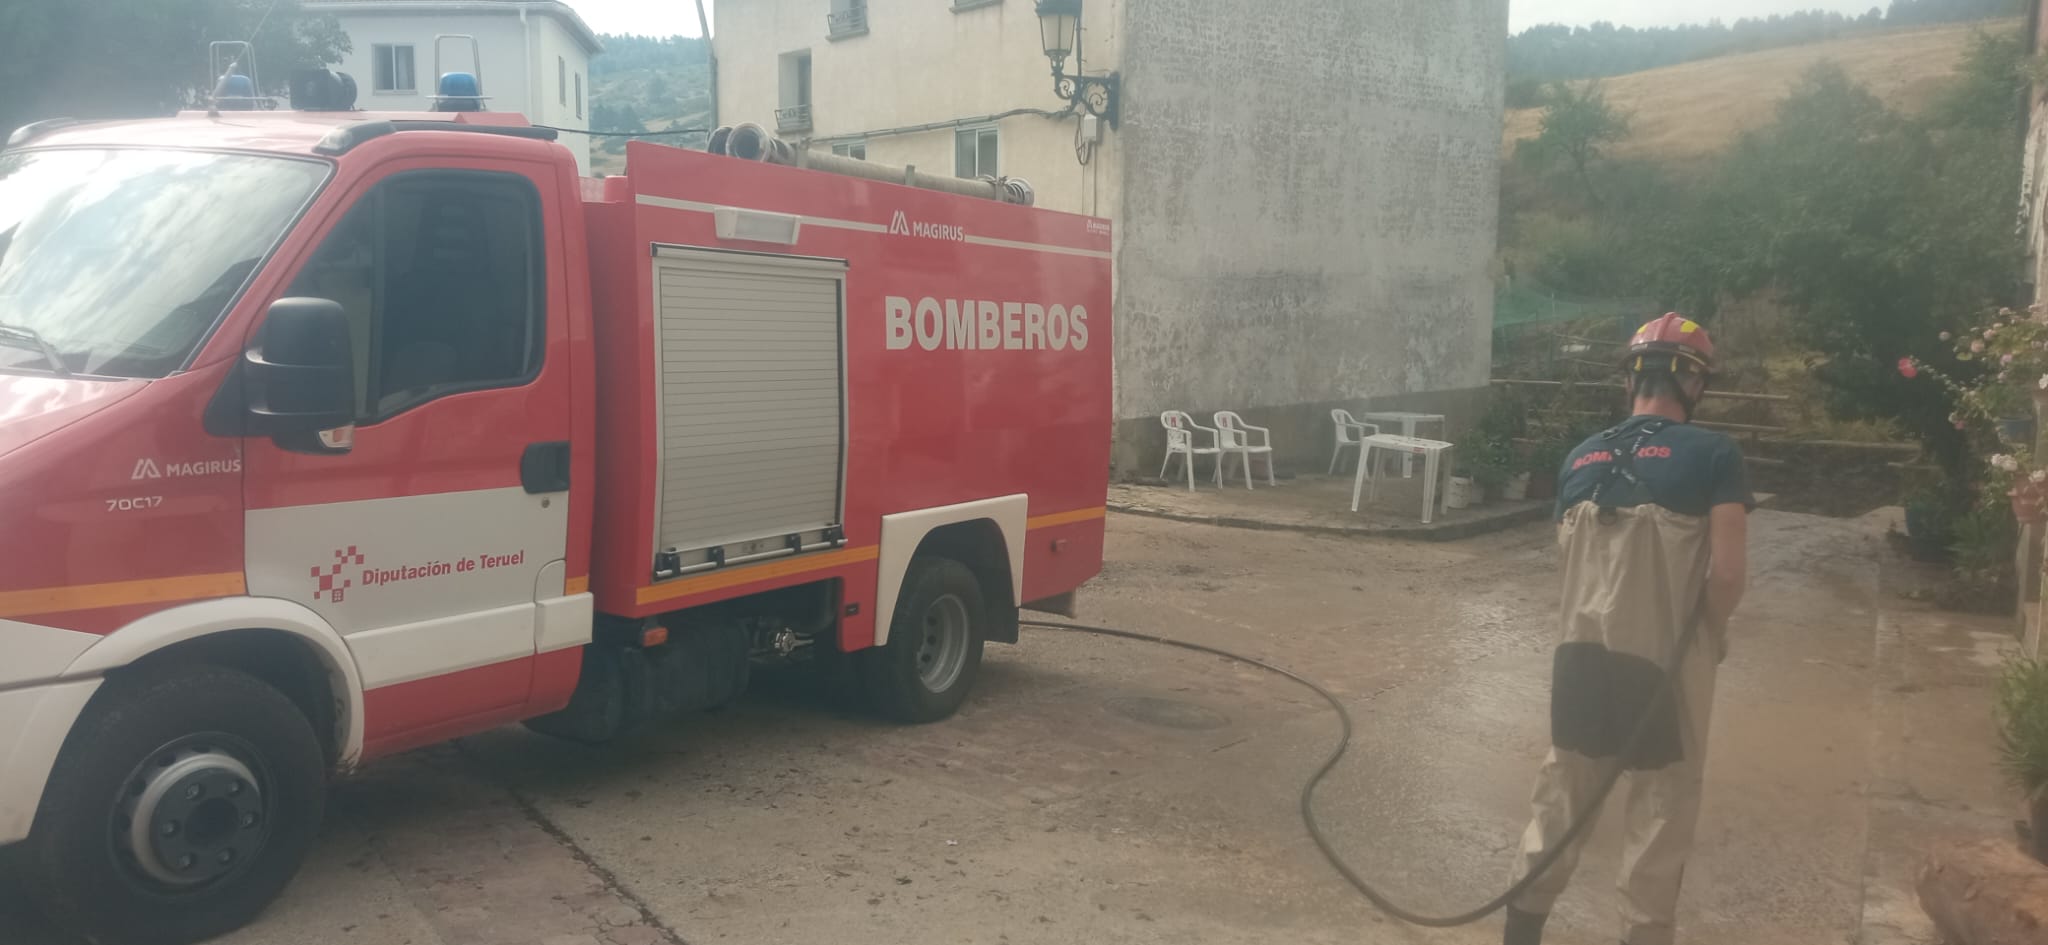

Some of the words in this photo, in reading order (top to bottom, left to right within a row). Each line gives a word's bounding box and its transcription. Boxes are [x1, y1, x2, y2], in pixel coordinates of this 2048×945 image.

[912, 221, 964, 242] MAGIRUS
[885, 296, 1089, 351] BOMBEROS
[166, 459, 242, 477] MAGIRUS
[1571, 446, 1672, 470] BOMROS
[105, 496, 163, 512] 70C17
[362, 561, 451, 586] Diputación
[456, 557, 475, 573] de
[480, 549, 524, 569] Teruel
